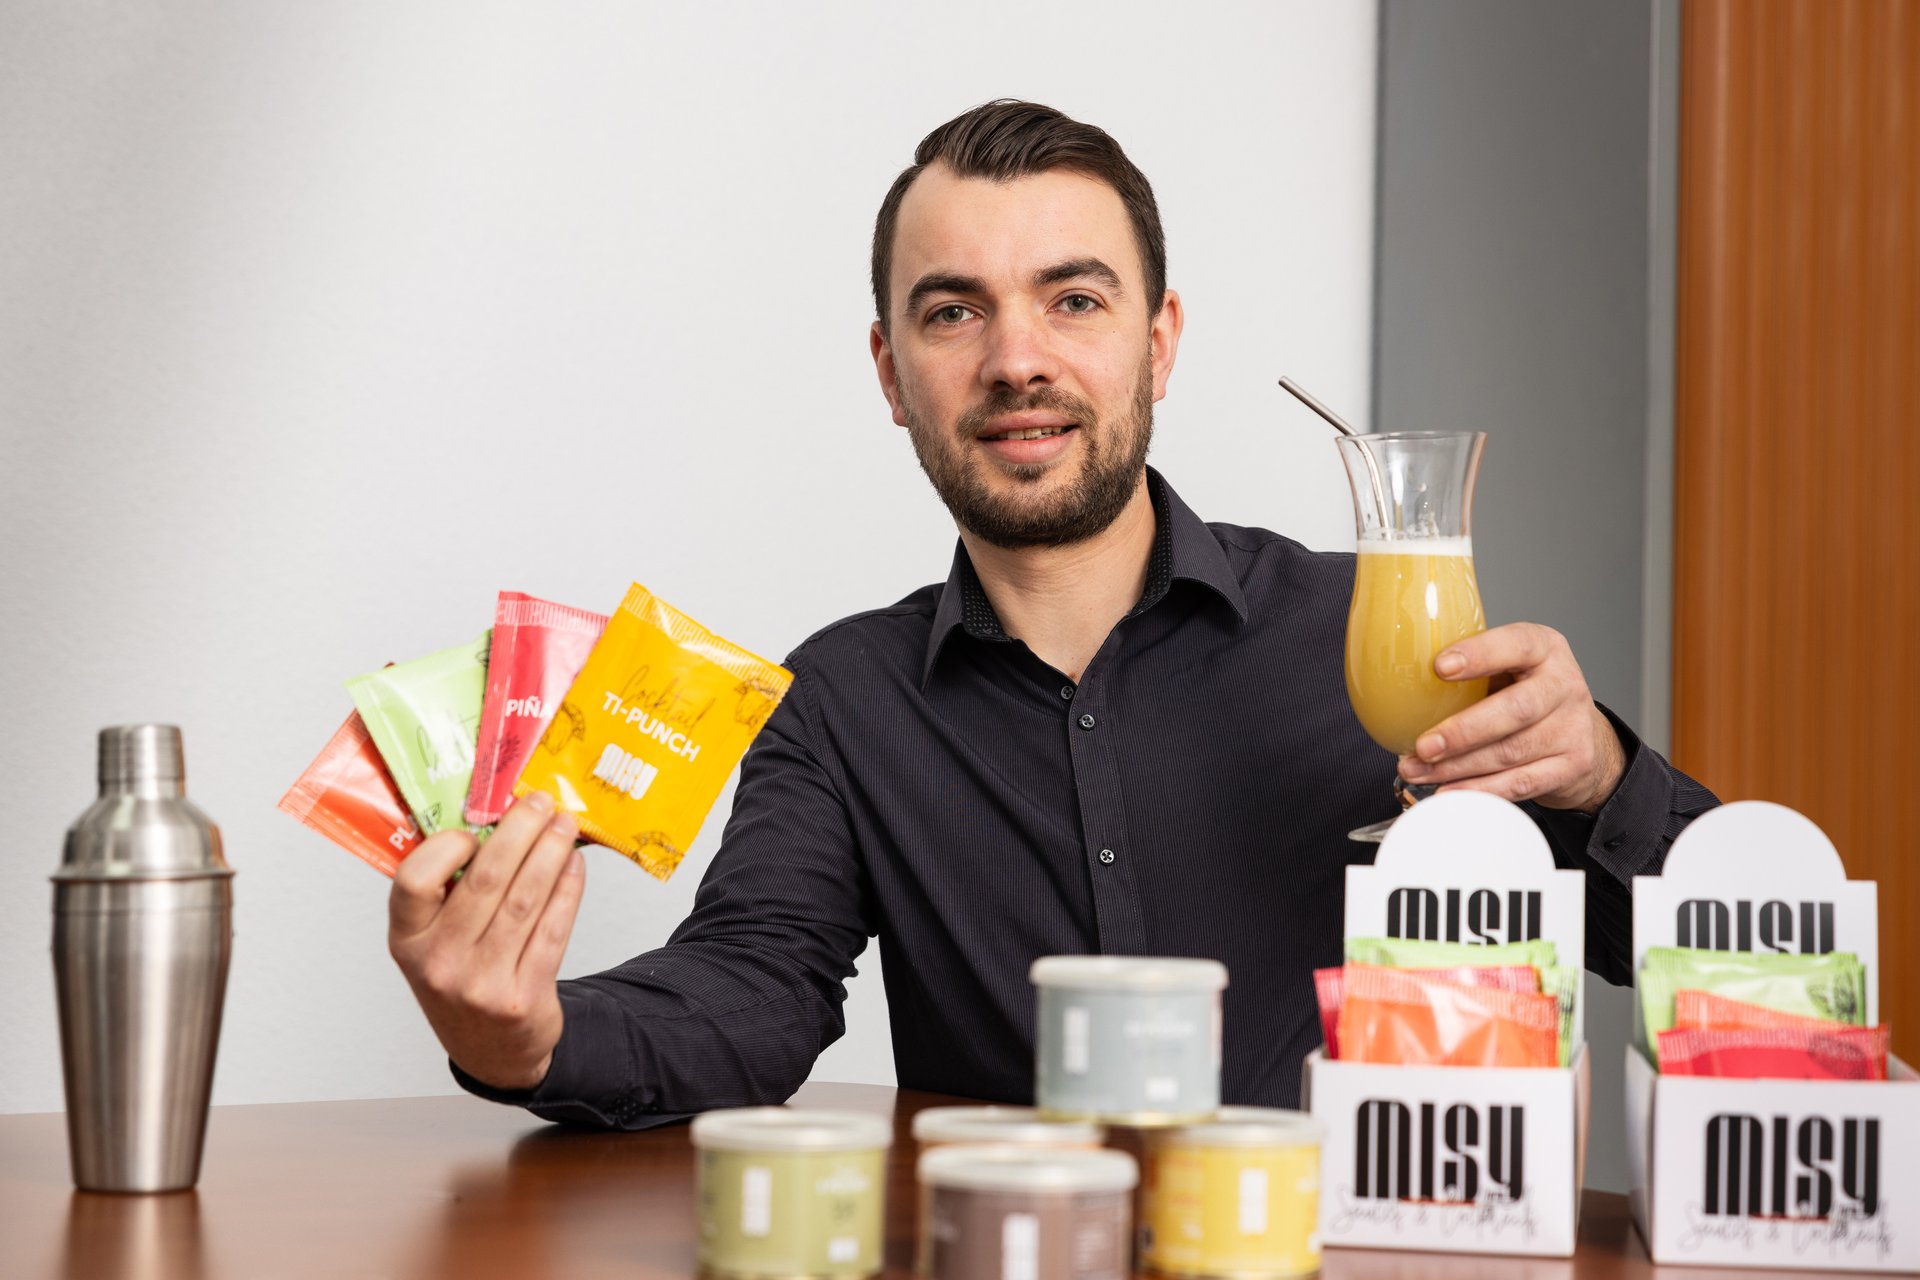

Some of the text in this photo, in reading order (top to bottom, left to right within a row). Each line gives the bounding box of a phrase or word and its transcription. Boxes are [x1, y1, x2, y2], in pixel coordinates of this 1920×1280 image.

[505, 696, 554, 719] PIÑA
[602, 690, 701, 763] TI-PUNCH
[388, 815, 418, 852] PL
[1355, 1099, 1523, 1203] MISY
[1704, 1114, 1880, 1219] MISY
